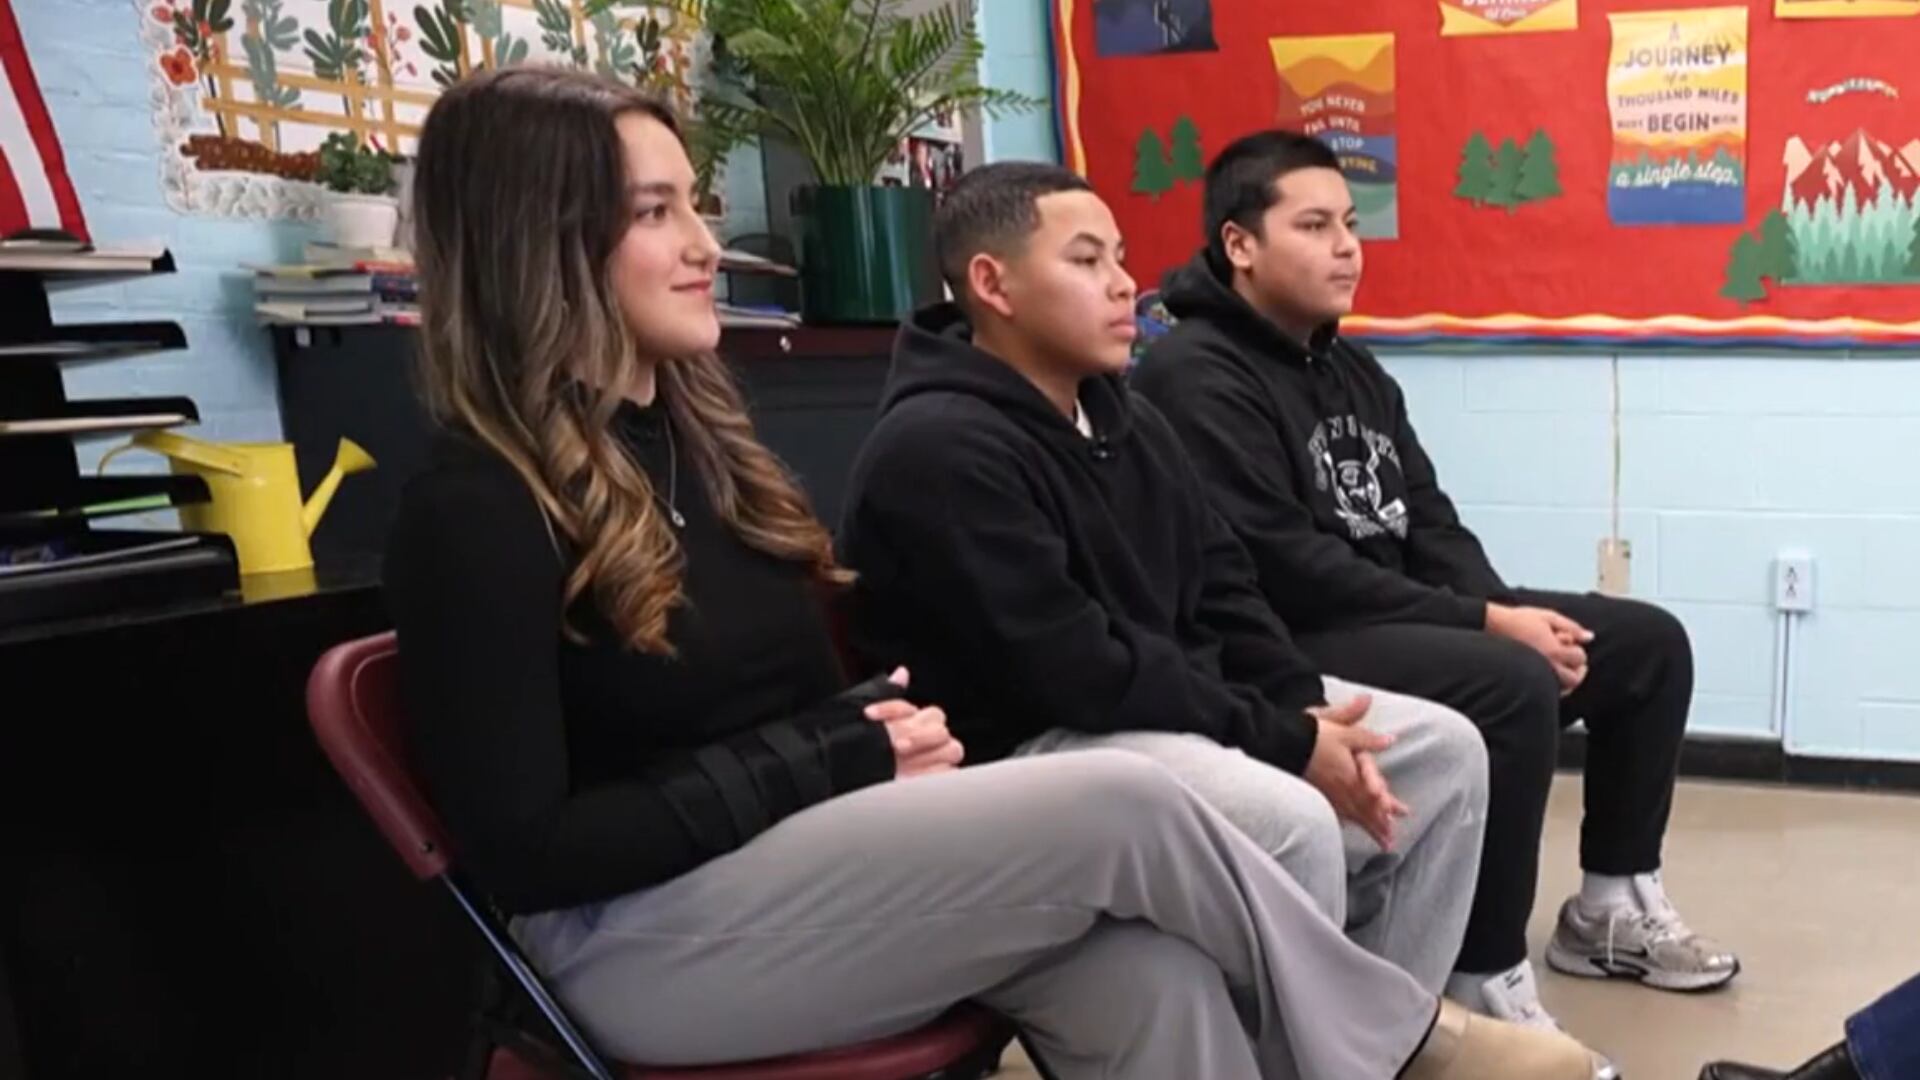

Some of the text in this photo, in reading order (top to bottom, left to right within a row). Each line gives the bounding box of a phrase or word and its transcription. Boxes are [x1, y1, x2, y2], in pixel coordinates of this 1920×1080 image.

[1669, 21, 1680, 40] A
[1624, 42, 1731, 68] JOURNEY
[1301, 94, 1366, 116] YOU NEVER
[1617, 87, 1739, 107] THOUSAND MILES
[1328, 115, 1360, 133] UNTIL
[1647, 112, 1710, 133] BEGIN
[1331, 135, 1364, 152] STOP
[1338, 156, 1378, 173] RYING
[1616, 171, 1630, 188] a
[1633, 158, 1691, 189] single
